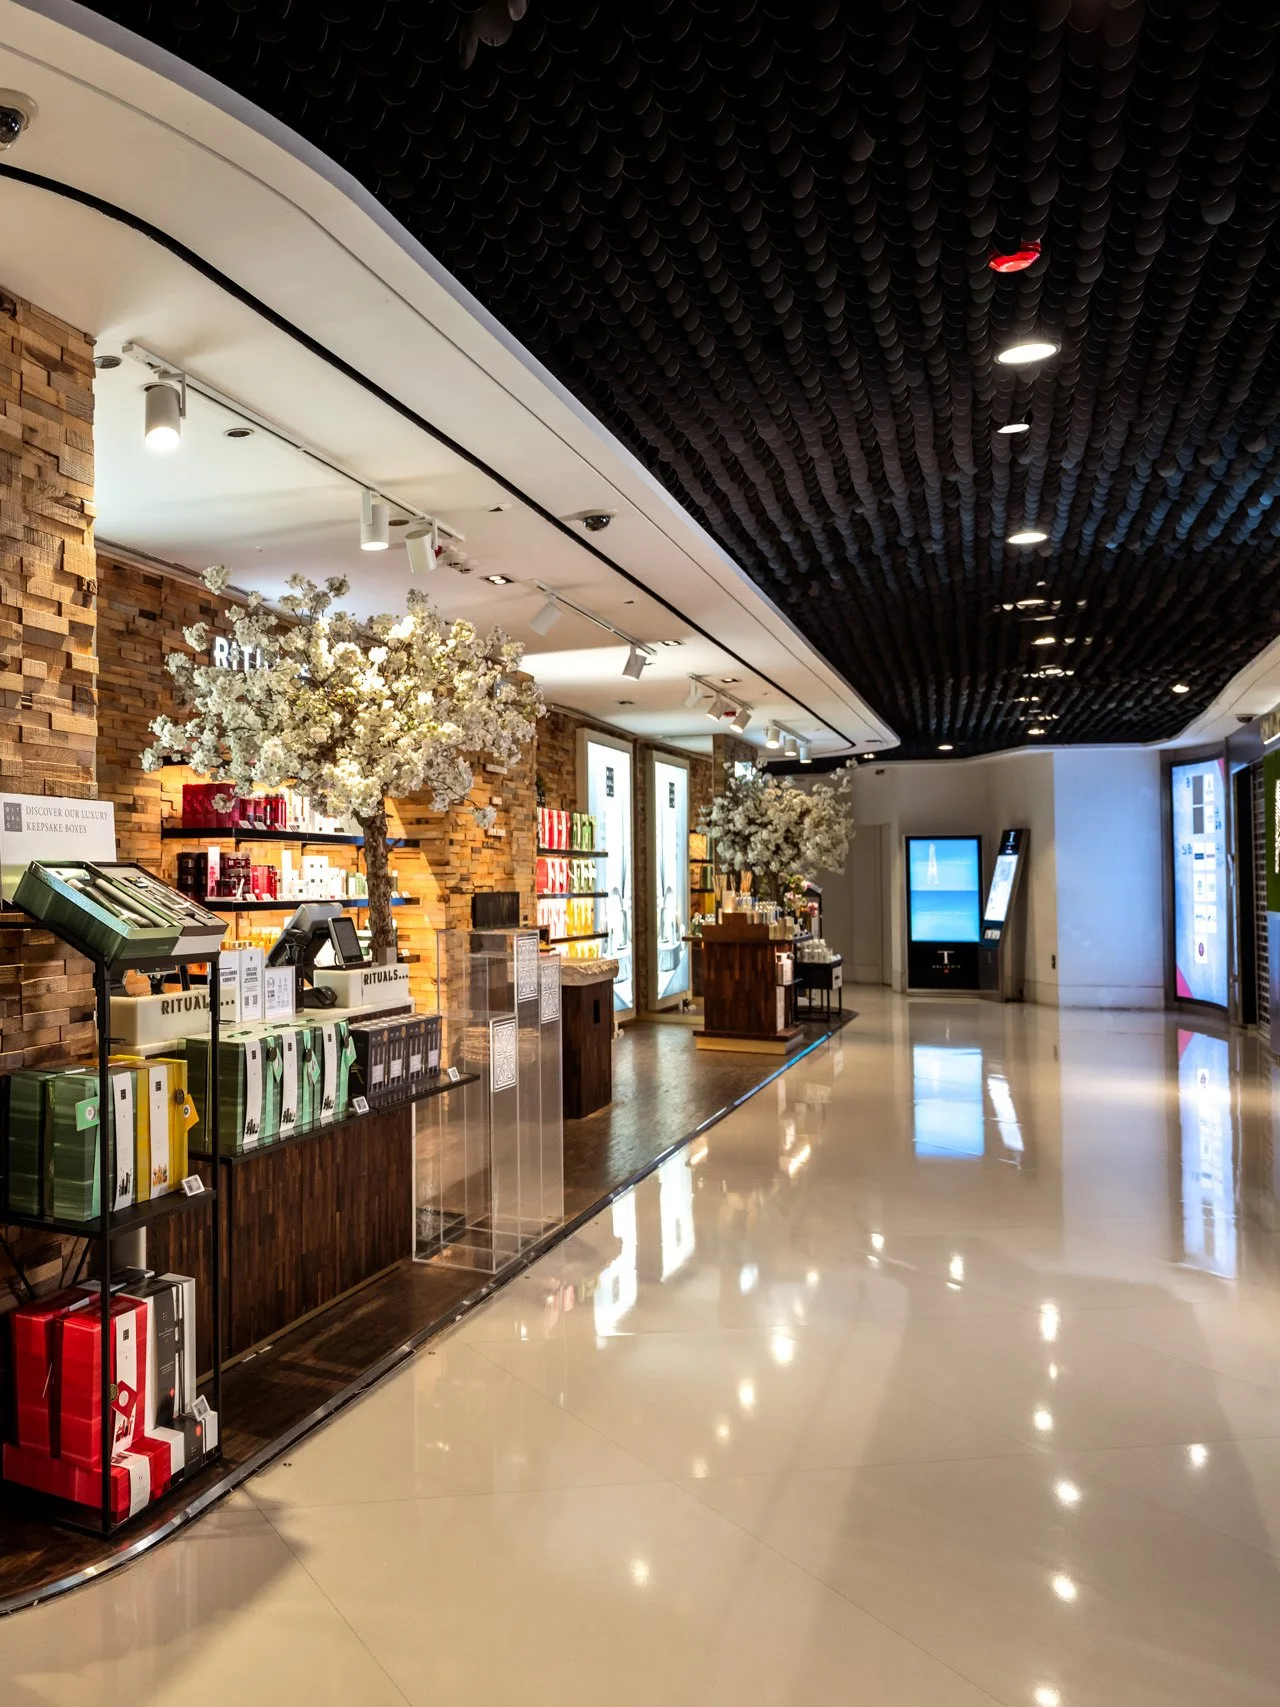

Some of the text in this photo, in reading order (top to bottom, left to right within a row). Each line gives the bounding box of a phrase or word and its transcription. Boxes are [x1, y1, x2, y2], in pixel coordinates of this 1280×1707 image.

[25, 805, 108, 821] DISCOVER OUR LUXURY
[26, 821, 87, 834] KEEPSAKE BOXES
[363, 969, 409, 985] RITUALS...
[161, 994, 235, 1015] RITUAL...
